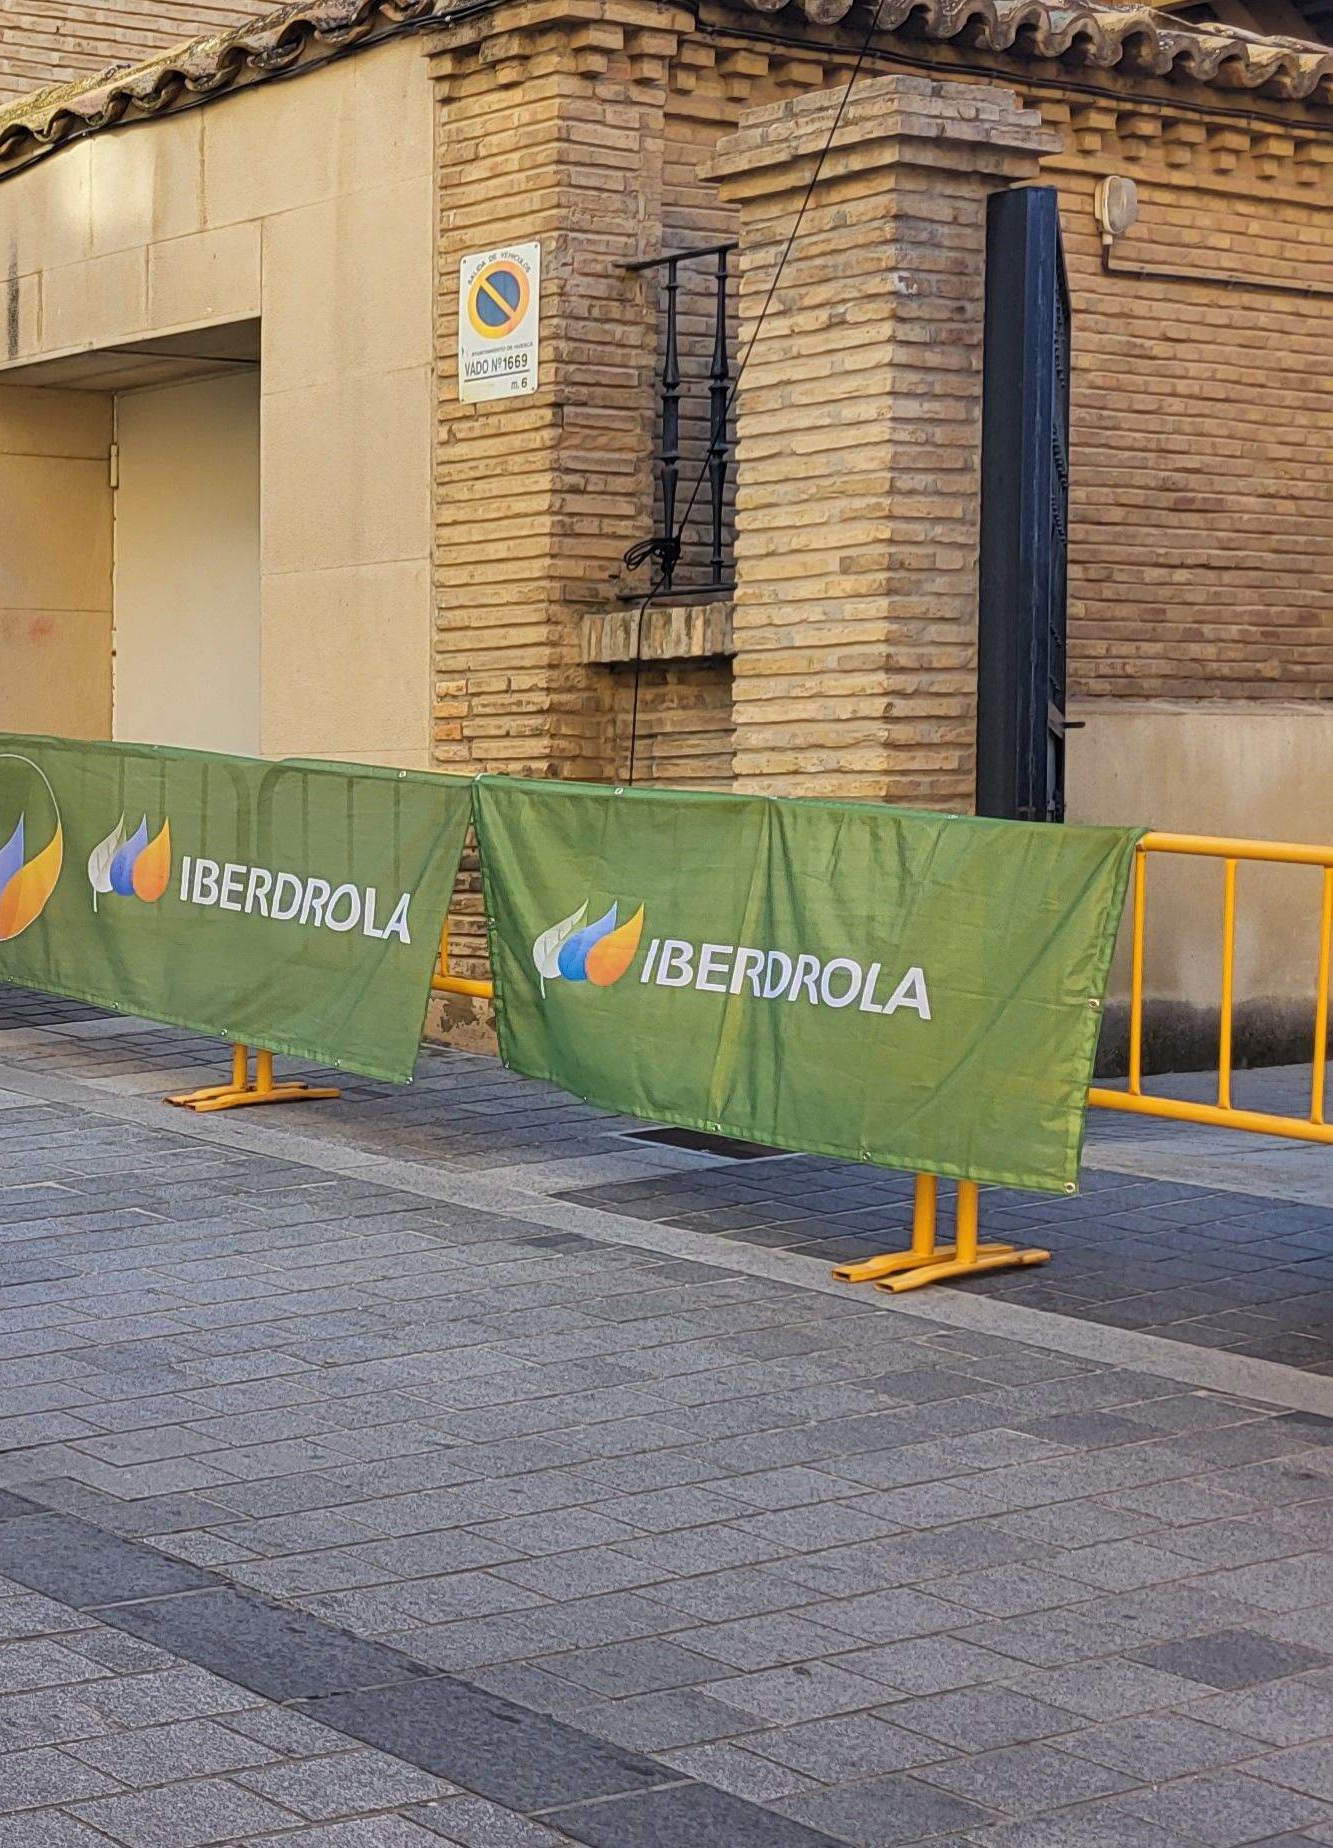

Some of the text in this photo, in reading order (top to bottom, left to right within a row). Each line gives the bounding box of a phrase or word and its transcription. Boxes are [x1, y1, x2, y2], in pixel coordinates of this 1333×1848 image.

[465, 360, 489, 377] VADO
[521, 377, 527, 388] 6
[179, 855, 411, 945] IBERDROLA
[640, 938, 932, 1020] IBERDROLA
